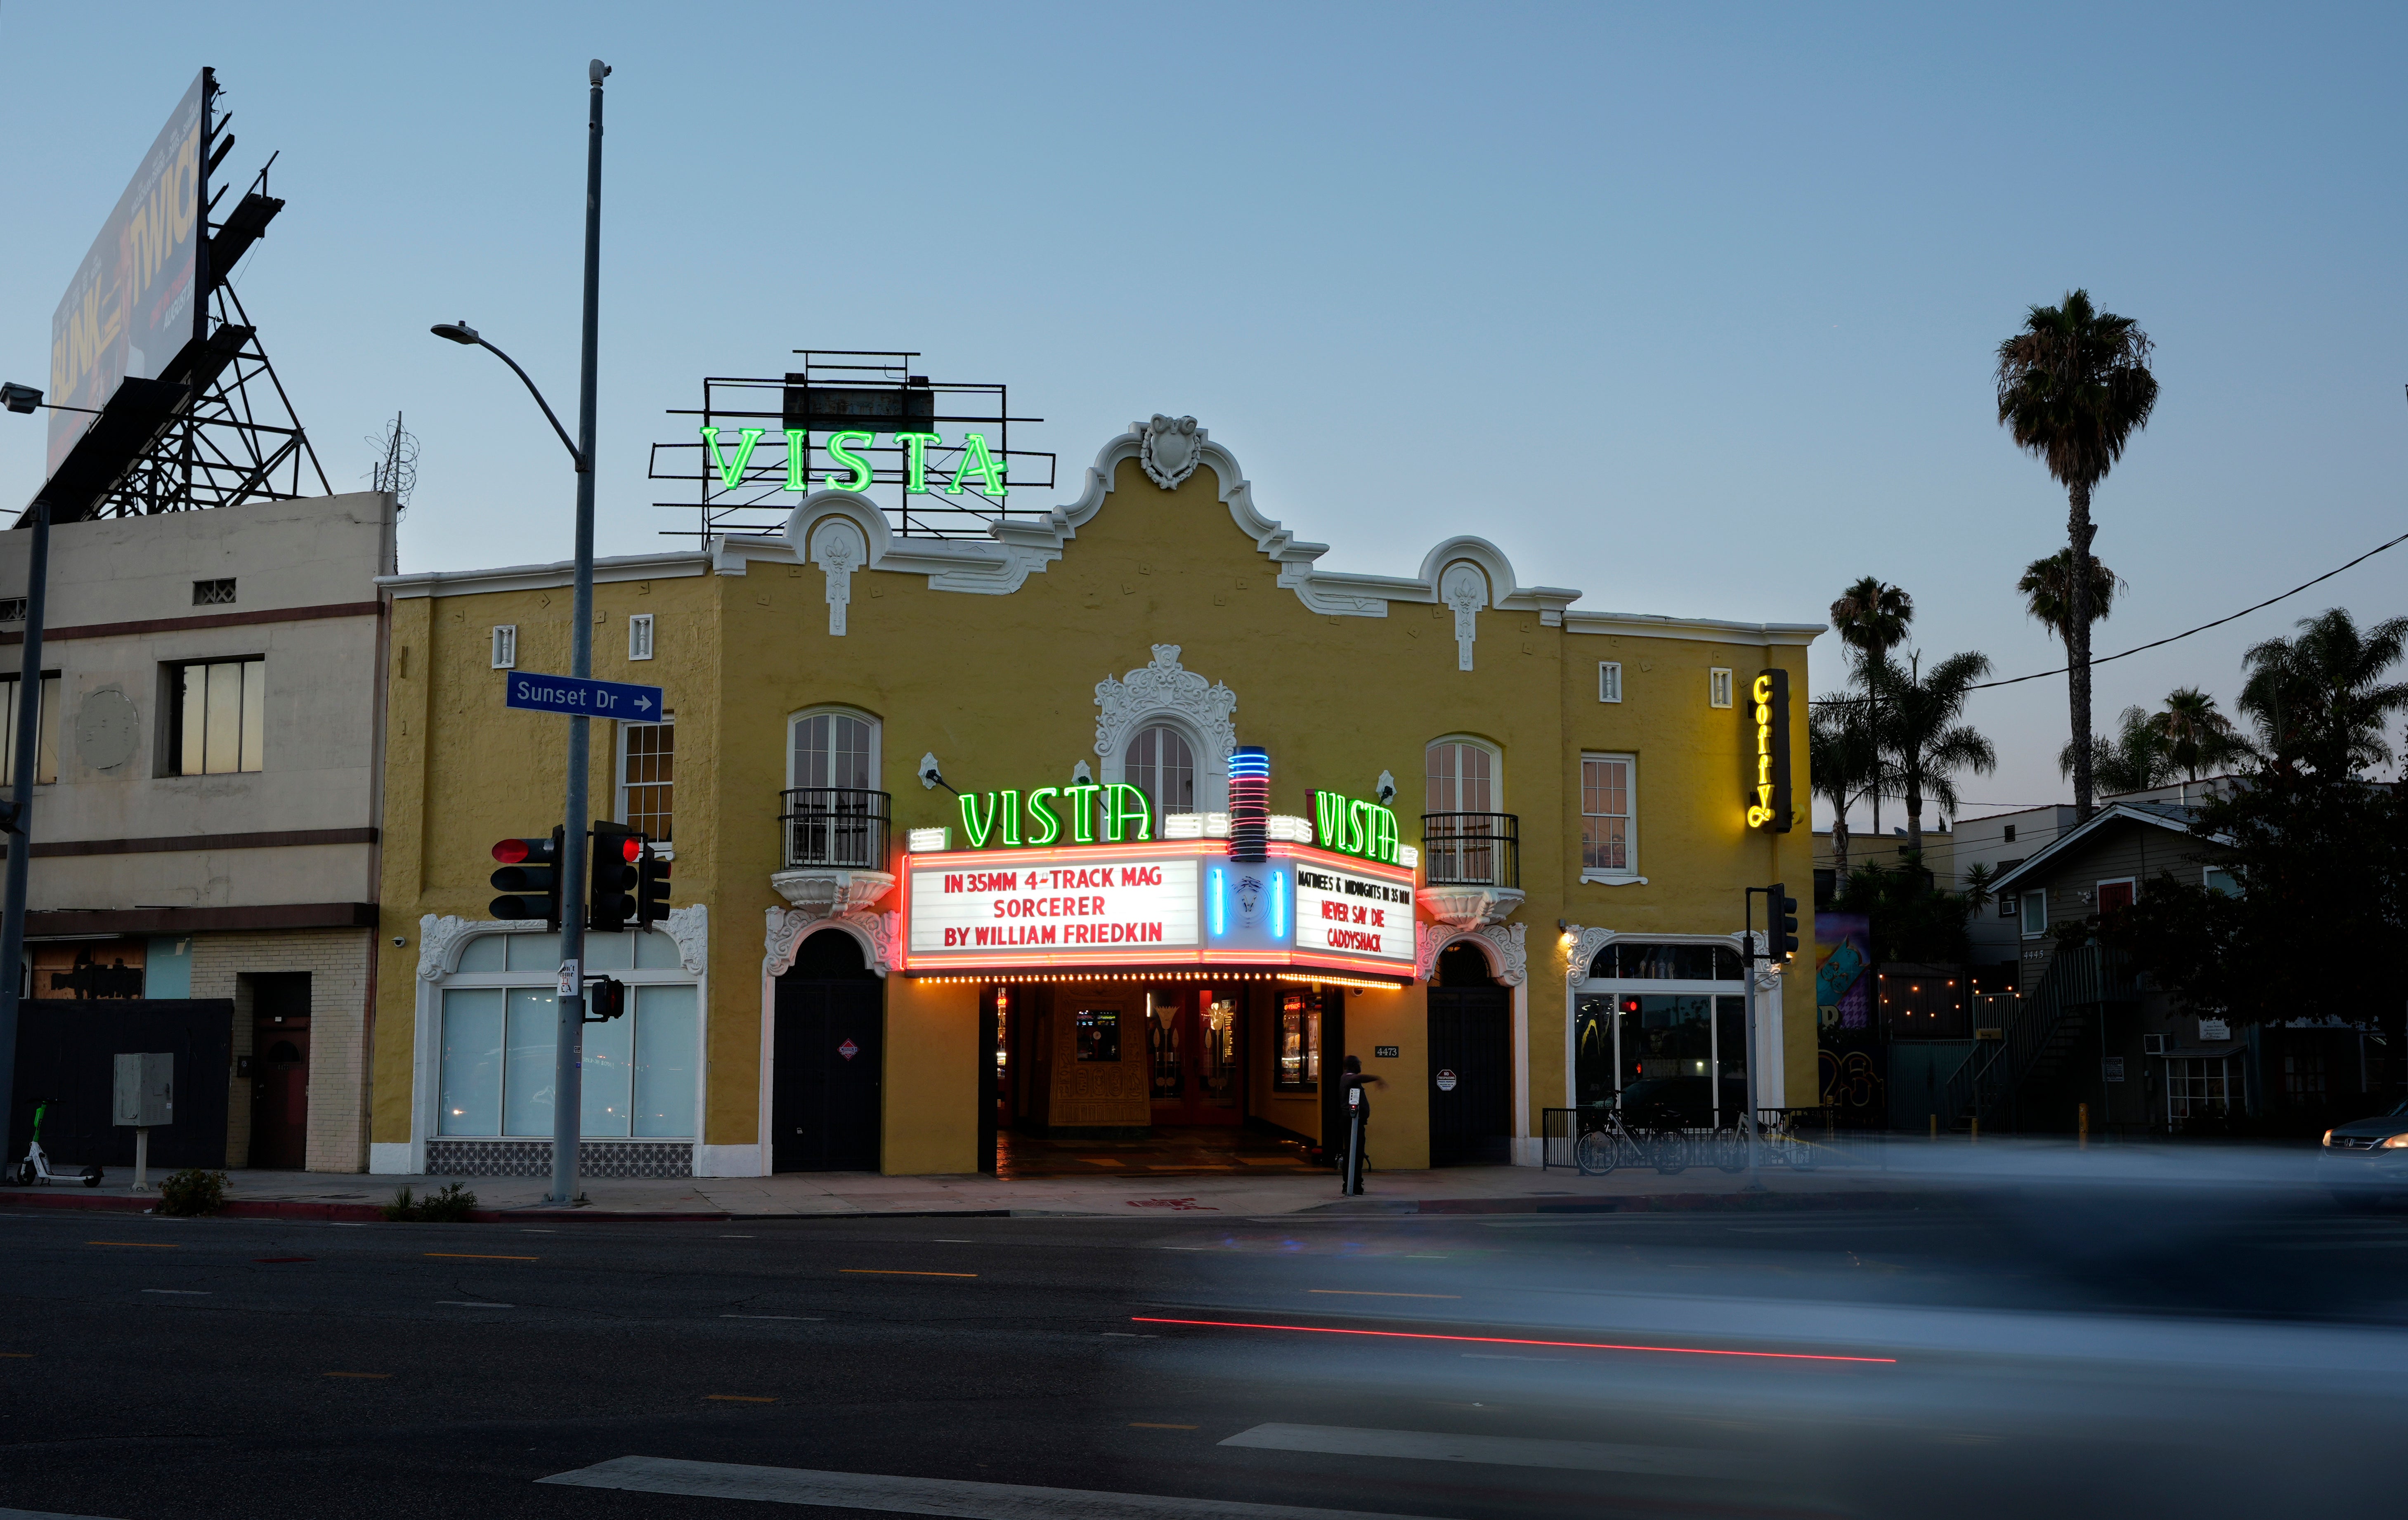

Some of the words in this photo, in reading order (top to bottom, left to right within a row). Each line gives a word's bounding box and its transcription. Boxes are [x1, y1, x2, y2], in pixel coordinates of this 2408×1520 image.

[50, 272, 102, 420] BLINK
[130, 119, 200, 305] TWICE
[163, 284, 187, 333] AUGUST
[699, 427, 1009, 496] VISTA
[518, 681, 586, 706] Sunset
[596, 690, 618, 709] Dr
[959, 783, 1152, 847] VISTA
[1315, 789, 1399, 864] VISTA
[945, 874, 963, 893] IN
[967, 872, 1016, 892] 35MM
[1024, 868, 1114, 890] 4-TRACK
[1122, 866, 1162, 887] MAG
[1298, 870, 1333, 891] MATINEES
[1336, 877, 1341, 892] &
[1345, 879, 1381, 899] MIDNIGHTS
[1382, 887, 1389, 901] IN
[994, 896, 1105, 918] SORCERER
[1321, 900, 1349, 922] NEVER
[1352, 906, 1367, 925] SAY
[1371, 909, 1384, 928] DIE
[945, 927, 970, 946] BY
[975, 925, 1056, 946] WILLIAM
[1064, 922, 1162, 944] FRIEDKIN
[1328, 928, 1381, 952] CADDYSHACK
[2024, 950, 2044, 959] 4445
[1377, 1048, 1397, 1056] 4473
